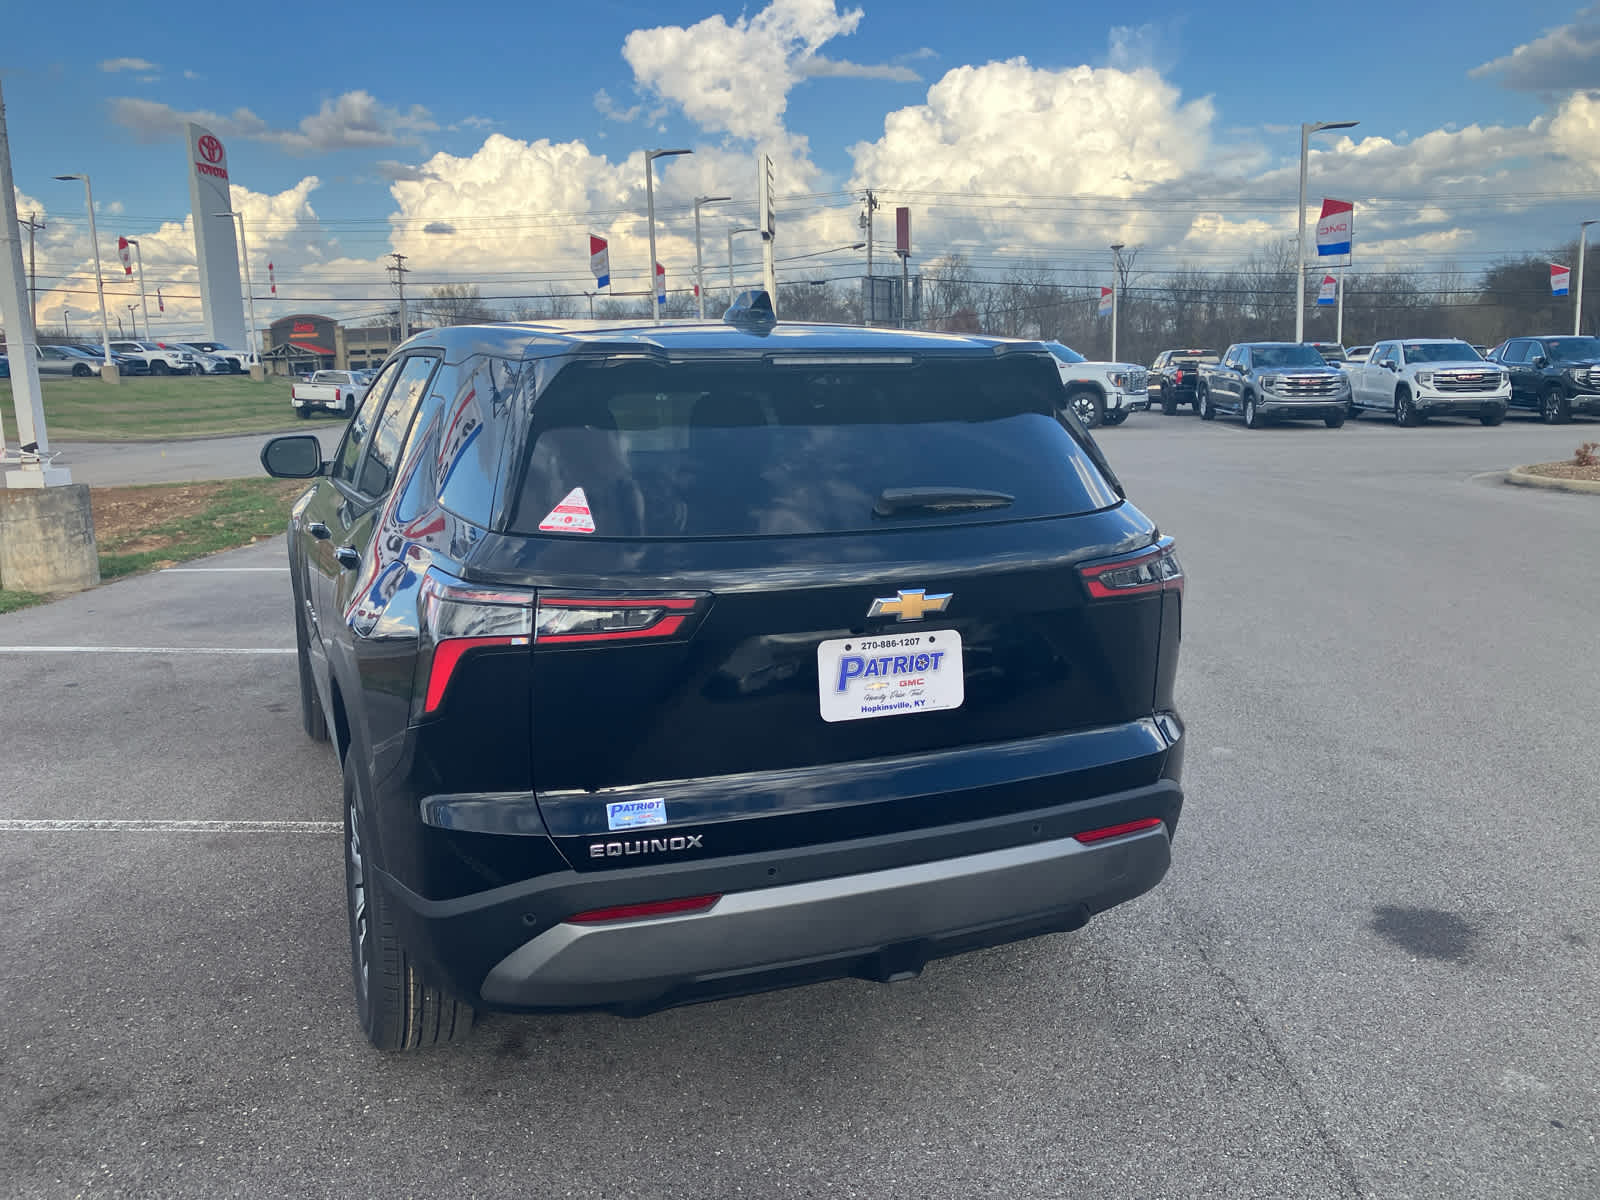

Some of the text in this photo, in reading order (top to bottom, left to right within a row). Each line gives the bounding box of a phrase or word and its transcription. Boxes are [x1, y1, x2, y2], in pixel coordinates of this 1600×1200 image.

[195, 162, 229, 180] TOYOTA
[861, 638, 920, 649] 270-886-1207
[837, 652, 944, 691] PATRIOT
[899, 678, 925, 687] GMC
[861, 699, 926, 713] Hopkinsville, KY
[611, 801, 662, 817] PATRIOT
[590, 834, 703, 857] EQUINOX
